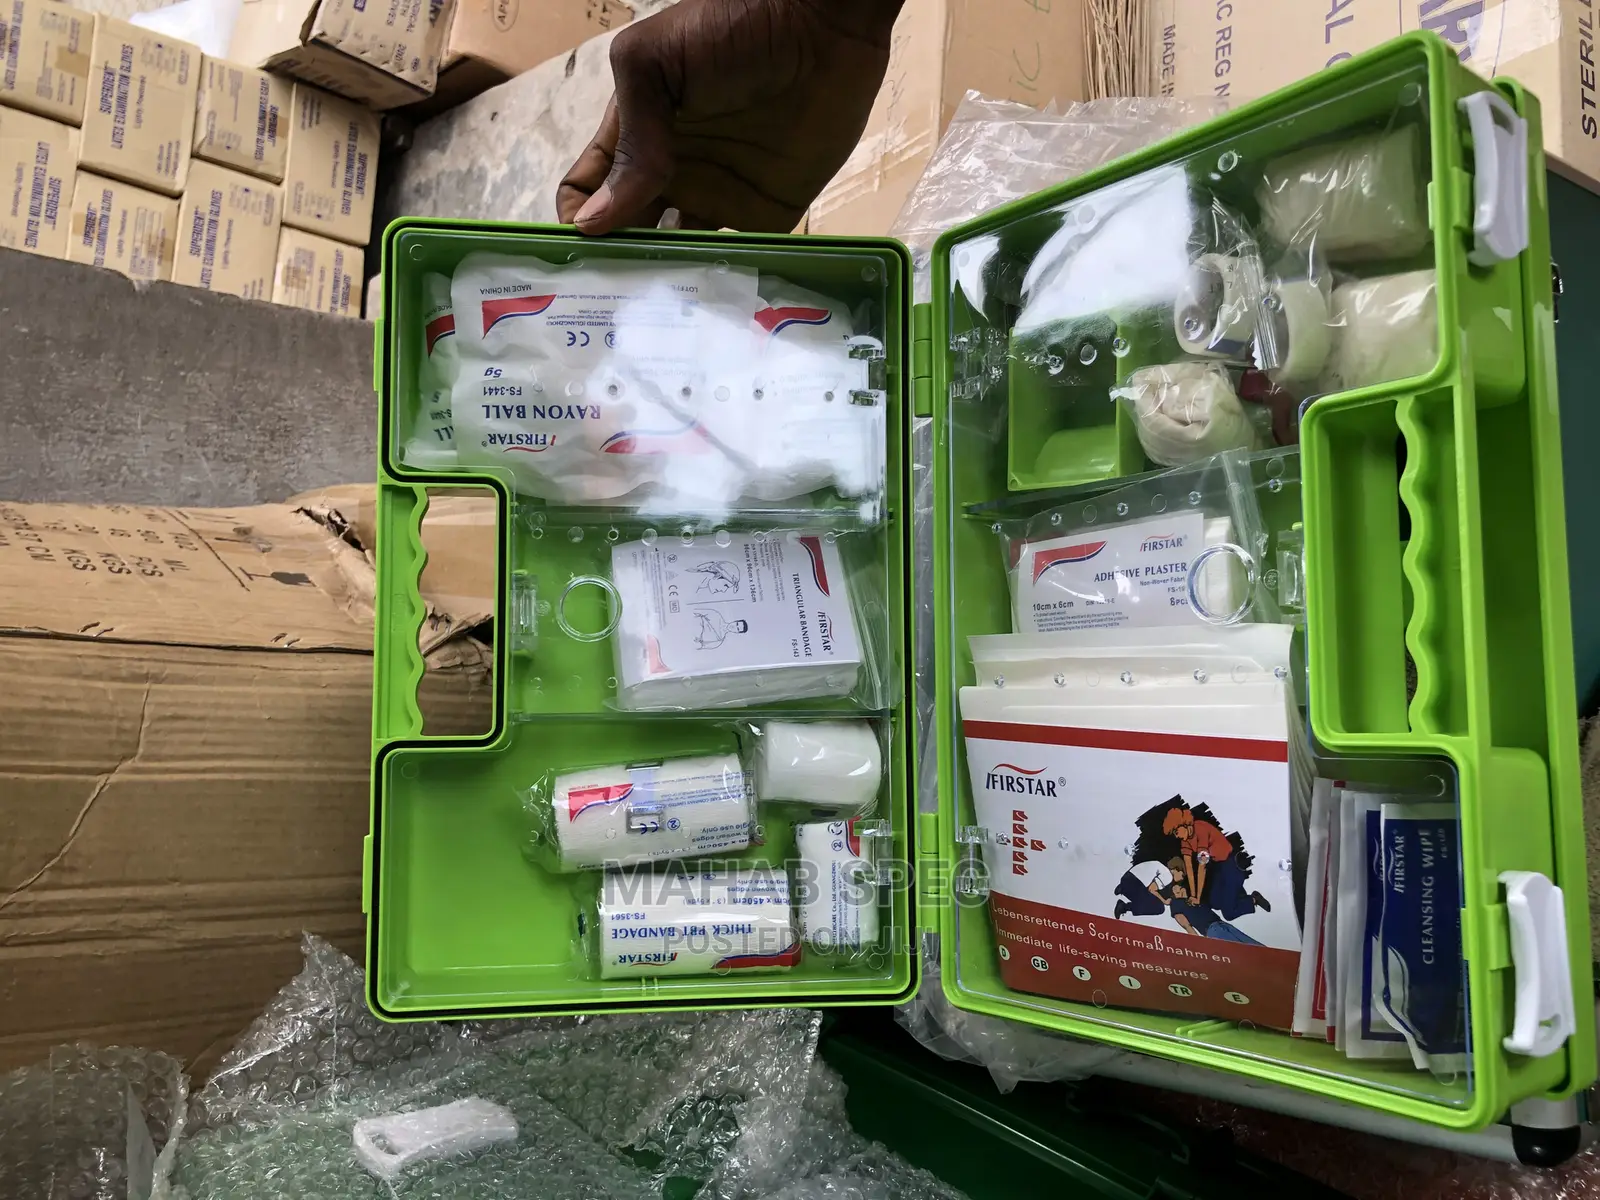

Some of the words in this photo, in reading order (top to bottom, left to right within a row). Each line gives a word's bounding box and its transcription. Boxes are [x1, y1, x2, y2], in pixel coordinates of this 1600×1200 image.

[1162, 24, 1175, 79] MADE
[1214, 25, 1232, 77] REG
[480, 286, 502, 295] CHINA
[503, 286, 511, 294] IN
[512, 284, 532, 293] MADE
[484, 367, 503, 378] 5g
[482, 386, 522, 396] FS-3441
[482, 404, 526, 420] BALL
[532, 404, 601, 420] RAYON
[1145, 562, 1187, 576] PLASTER
[1033, 603, 1051, 611] 10cm
[792, 573, 807, 619] TRIANGULAR
[800, 621, 812, 658] BANDAGE
[692, 835, 714, 843] edges
[1418, 829, 1434, 868] WIPE
[992, 900, 1084, 935] Lebensrettende
[1420, 875, 1434, 965] CLEANSING
[611, 927, 675, 939] BANDAGE
[682, 926, 705, 936] PBT
[712, 924, 753, 935] THICK
[995, 920, 1053, 950] Immediate
[1059, 943, 1127, 968] life-saving
[1131, 960, 1209, 981] measures
[1032, 958, 1048, 969] GB
[1171, 985, 1190, 995] TR
